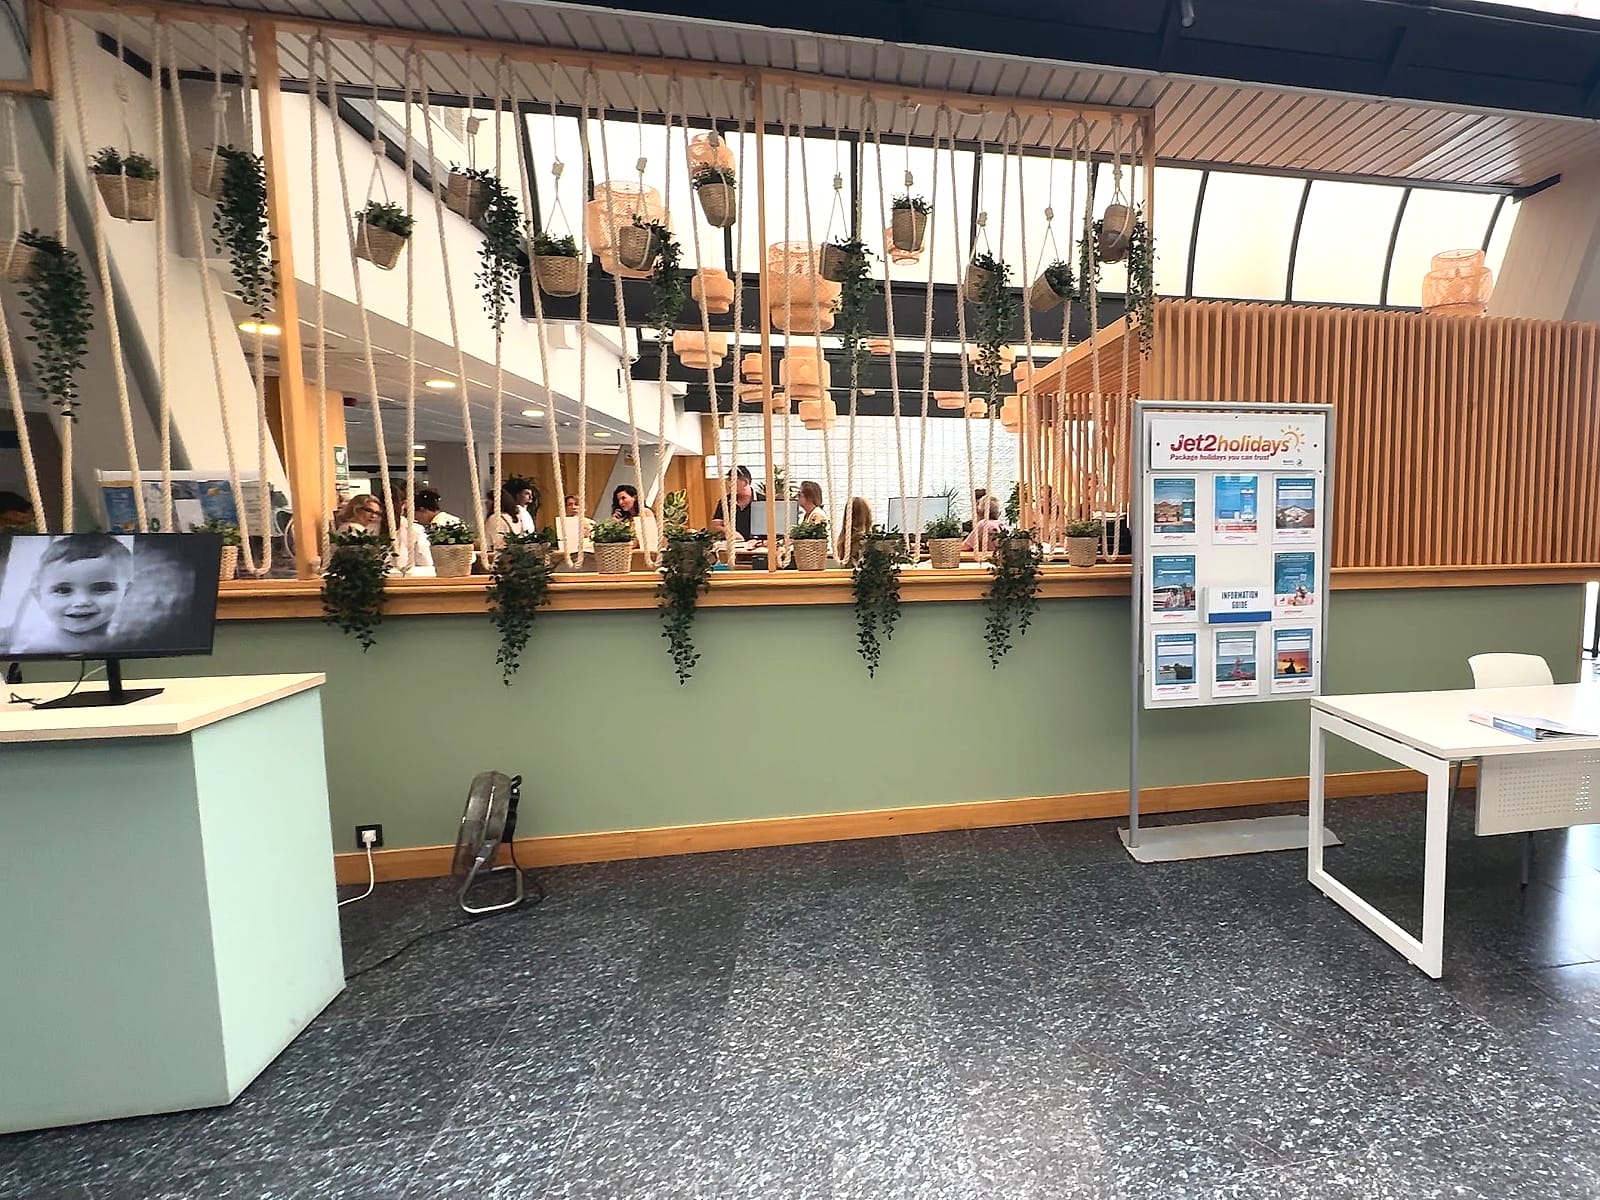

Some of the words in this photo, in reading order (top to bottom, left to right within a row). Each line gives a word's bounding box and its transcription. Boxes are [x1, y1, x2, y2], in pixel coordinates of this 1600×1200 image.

[1170, 453, 1198, 461] Package
[1200, 453, 1227, 461] holidays
[1221, 590, 1259, 600] INFORMATION
[1231, 600, 1248, 609] GUIDE
